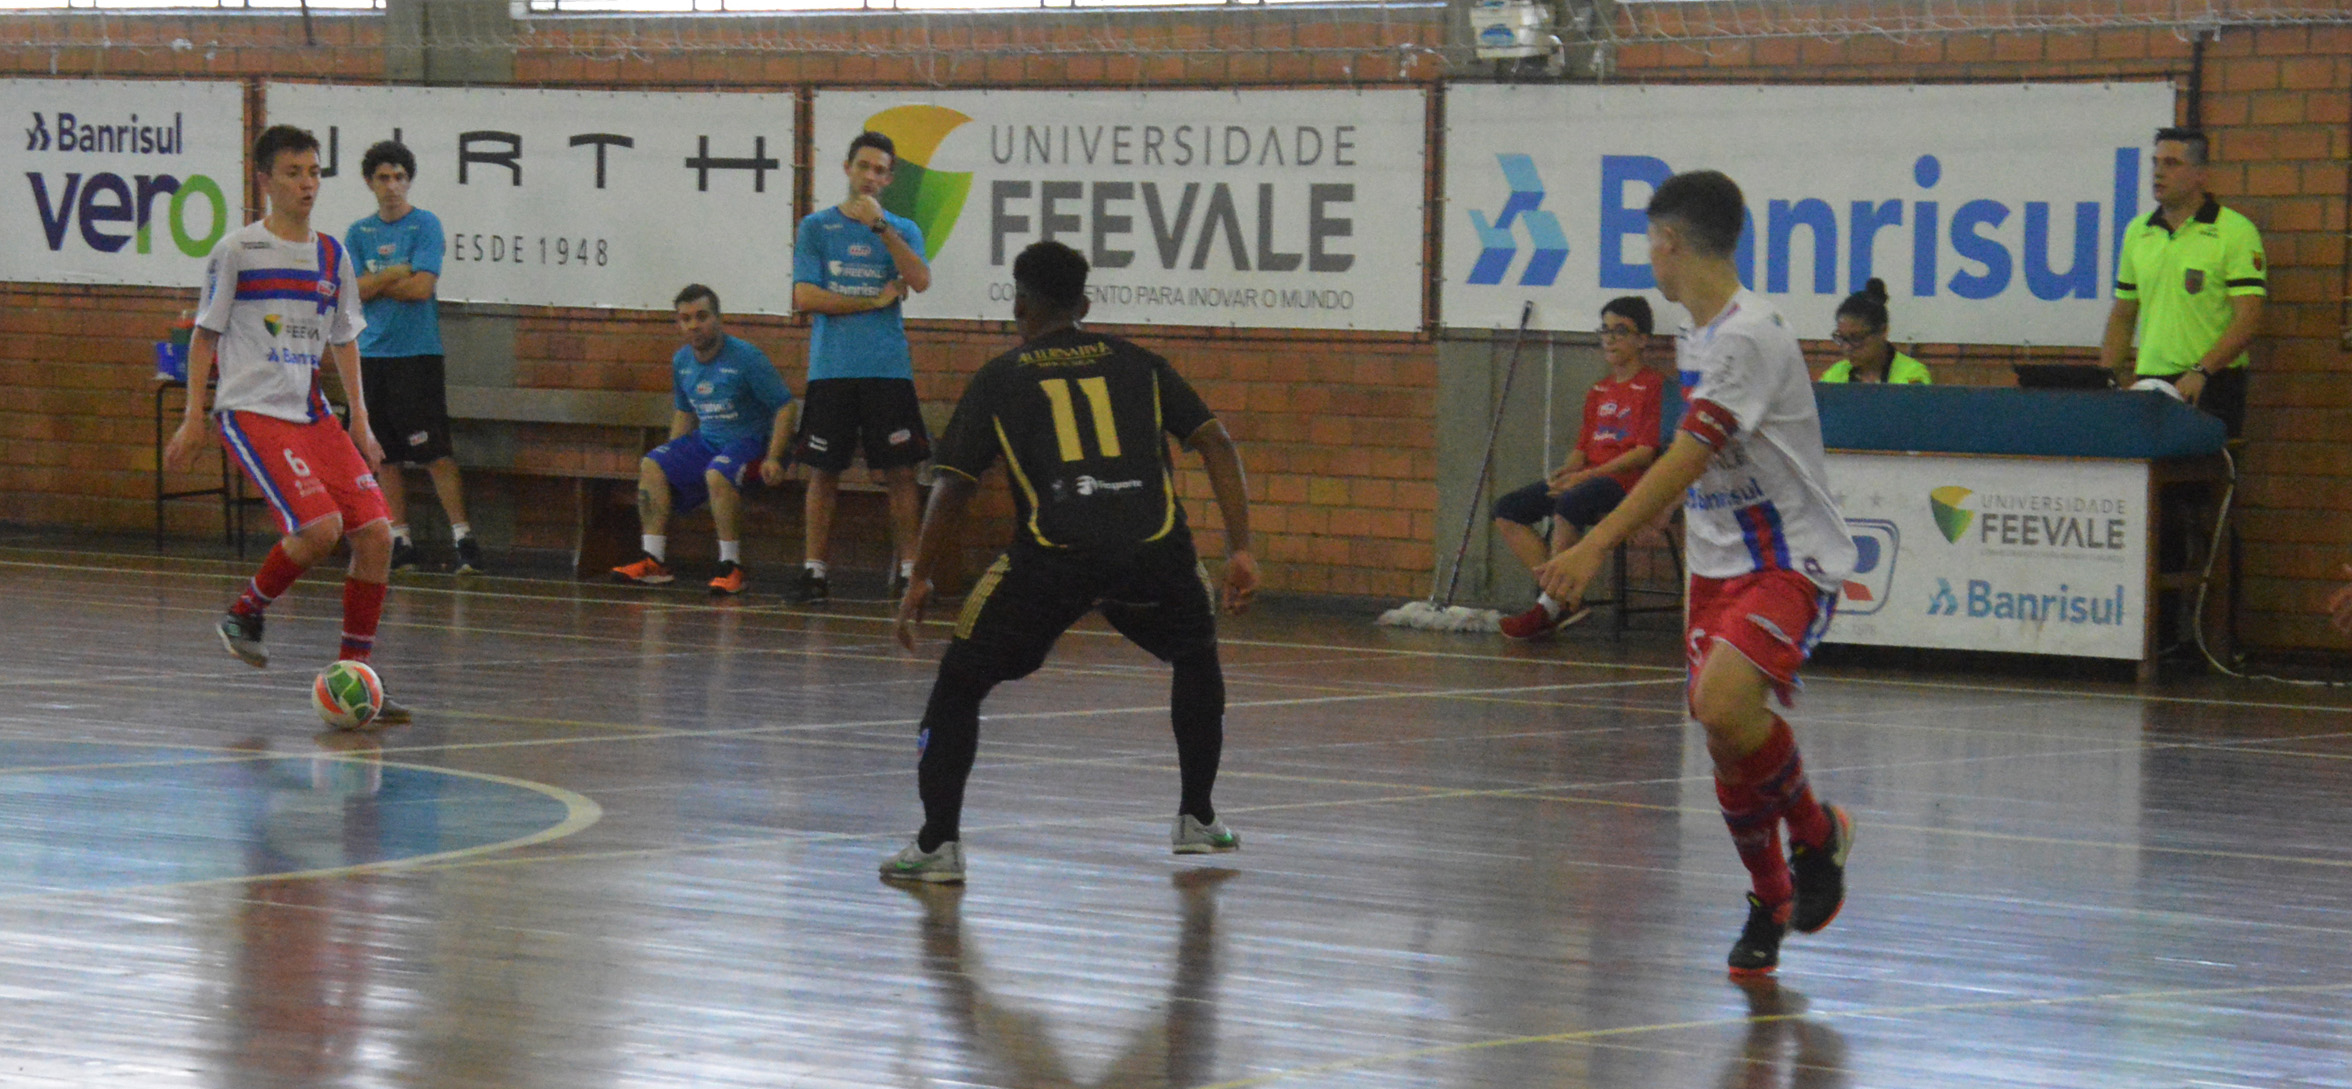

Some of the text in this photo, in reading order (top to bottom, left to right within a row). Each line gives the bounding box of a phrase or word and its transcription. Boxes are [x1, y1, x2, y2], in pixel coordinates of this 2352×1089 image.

[57, 111, 183, 155] Banrisul
[990, 124, 1357, 168] UNIVERSIDADE
[26, 171, 229, 258] vero
[989, 180, 1357, 273] FEEVALE
[1599, 145, 2142, 301] Bnrisul
[444, 232, 610, 267] ESDE 1948
[1136, 286, 1186, 307] PARA
[1188, 286, 1258, 308] INOVAR
[1261, 288, 1278, 309] O
[1281, 289, 1355, 311] MUNDO
[1038, 375, 1123, 463] 11
[282, 447, 311, 478] 6
[1980, 493, 2128, 515] UNIVERSIDADE
[1981, 512, 2127, 550] FEEVALE
[1967, 578, 2125, 627] Banrisul
